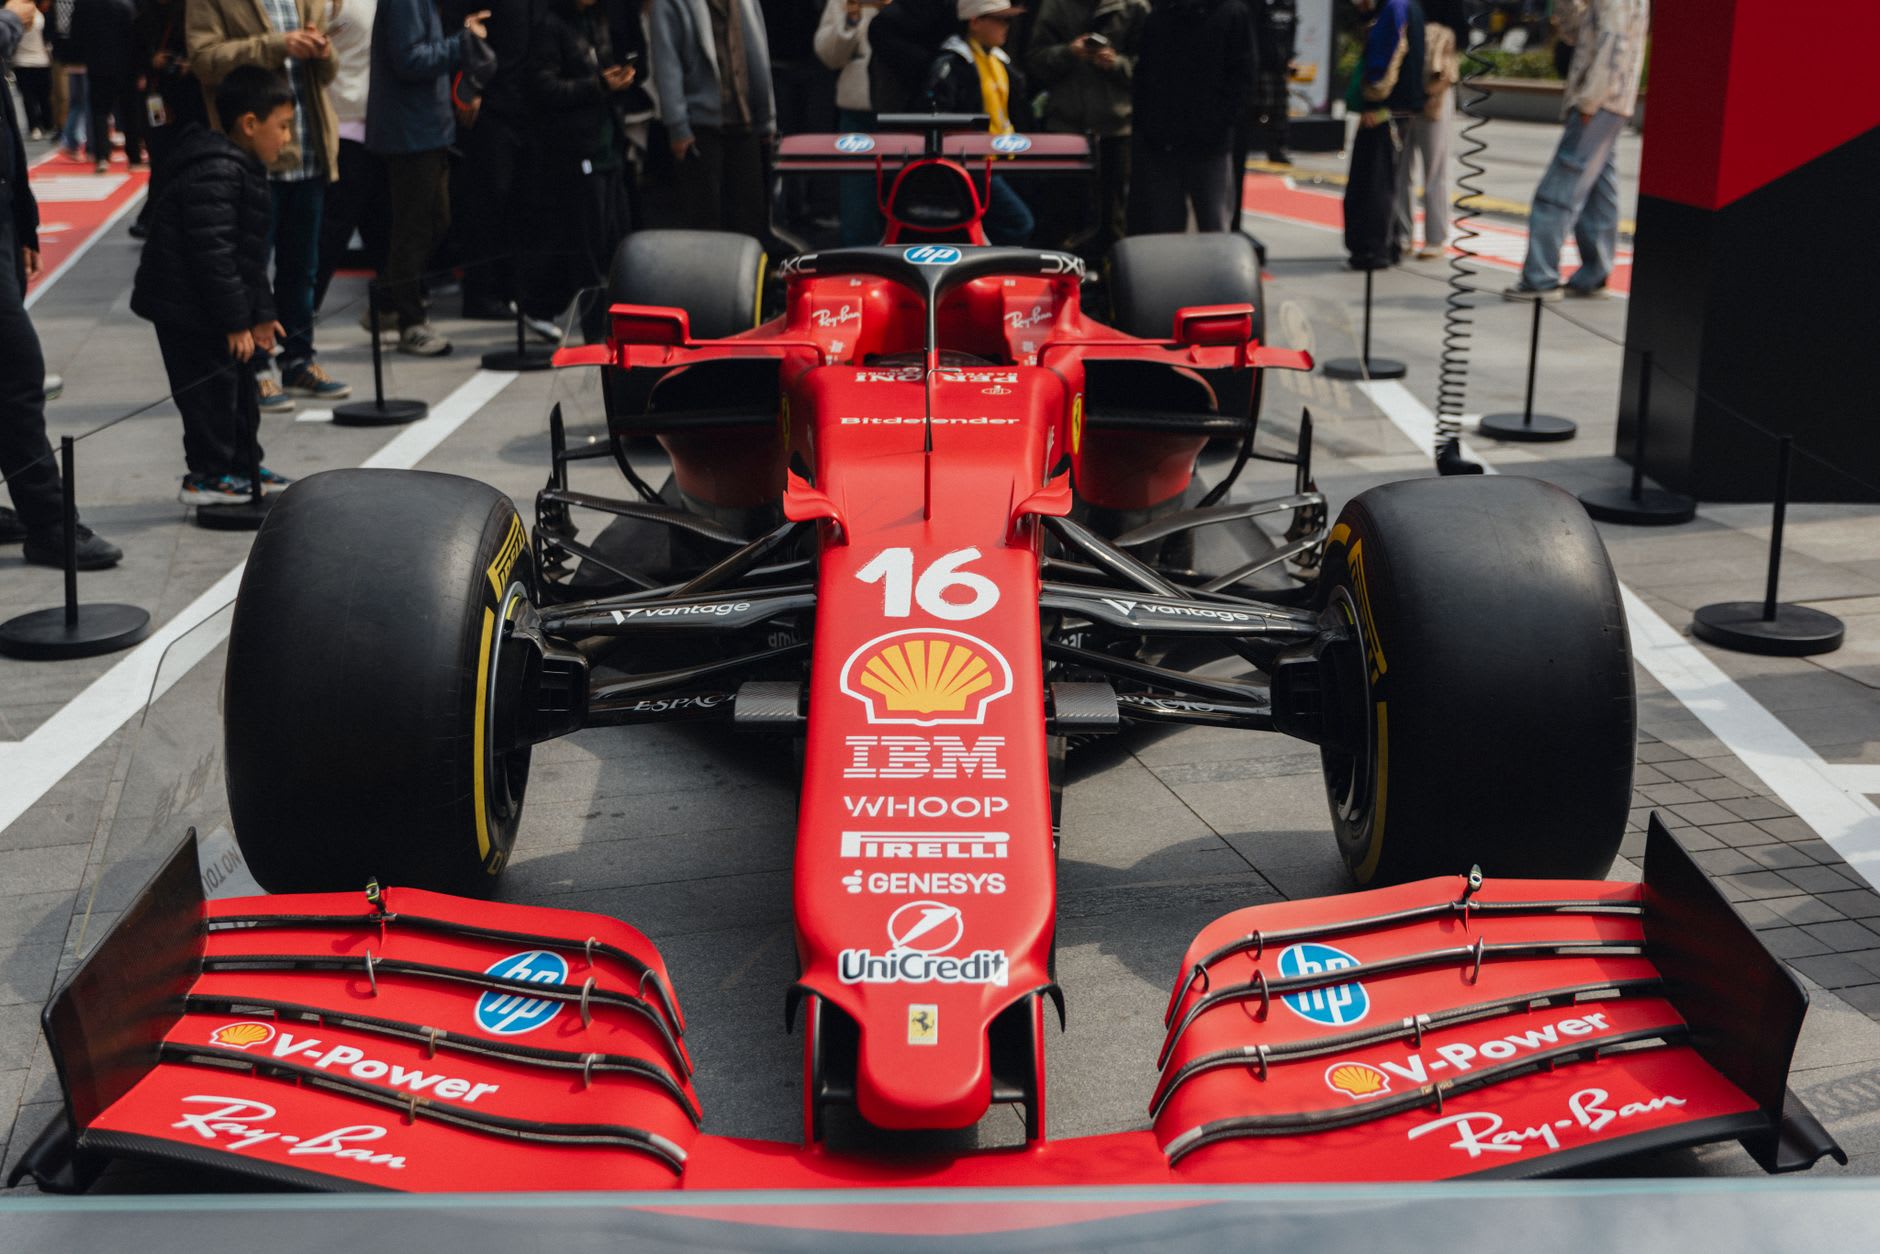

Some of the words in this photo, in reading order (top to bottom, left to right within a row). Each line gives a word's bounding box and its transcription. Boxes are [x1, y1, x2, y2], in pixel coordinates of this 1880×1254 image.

[779, 253, 818, 274] XC
[910, 246, 956, 263] hp
[855, 545, 1000, 620] 16
[645, 602, 750, 616] vantage
[1141, 603, 1250, 621] vantage
[633, 693, 736, 711] ESPAC
[843, 736, 1006, 778] IBM
[842, 796, 1009, 817] WHOOP
[840, 831, 1010, 858] PIRELLI
[868, 873, 1007, 894] GENESYS
[842, 952, 1005, 980] UniCredit
[483, 951, 560, 1032] hp
[1292, 945, 1353, 1025] hp
[1380, 1012, 1610, 1083] V-Power
[272, 1033, 500, 1102] V-Power
[171, 1095, 406, 1169] Ray-Ban
[1408, 1088, 1687, 1158] Ray-Ban
